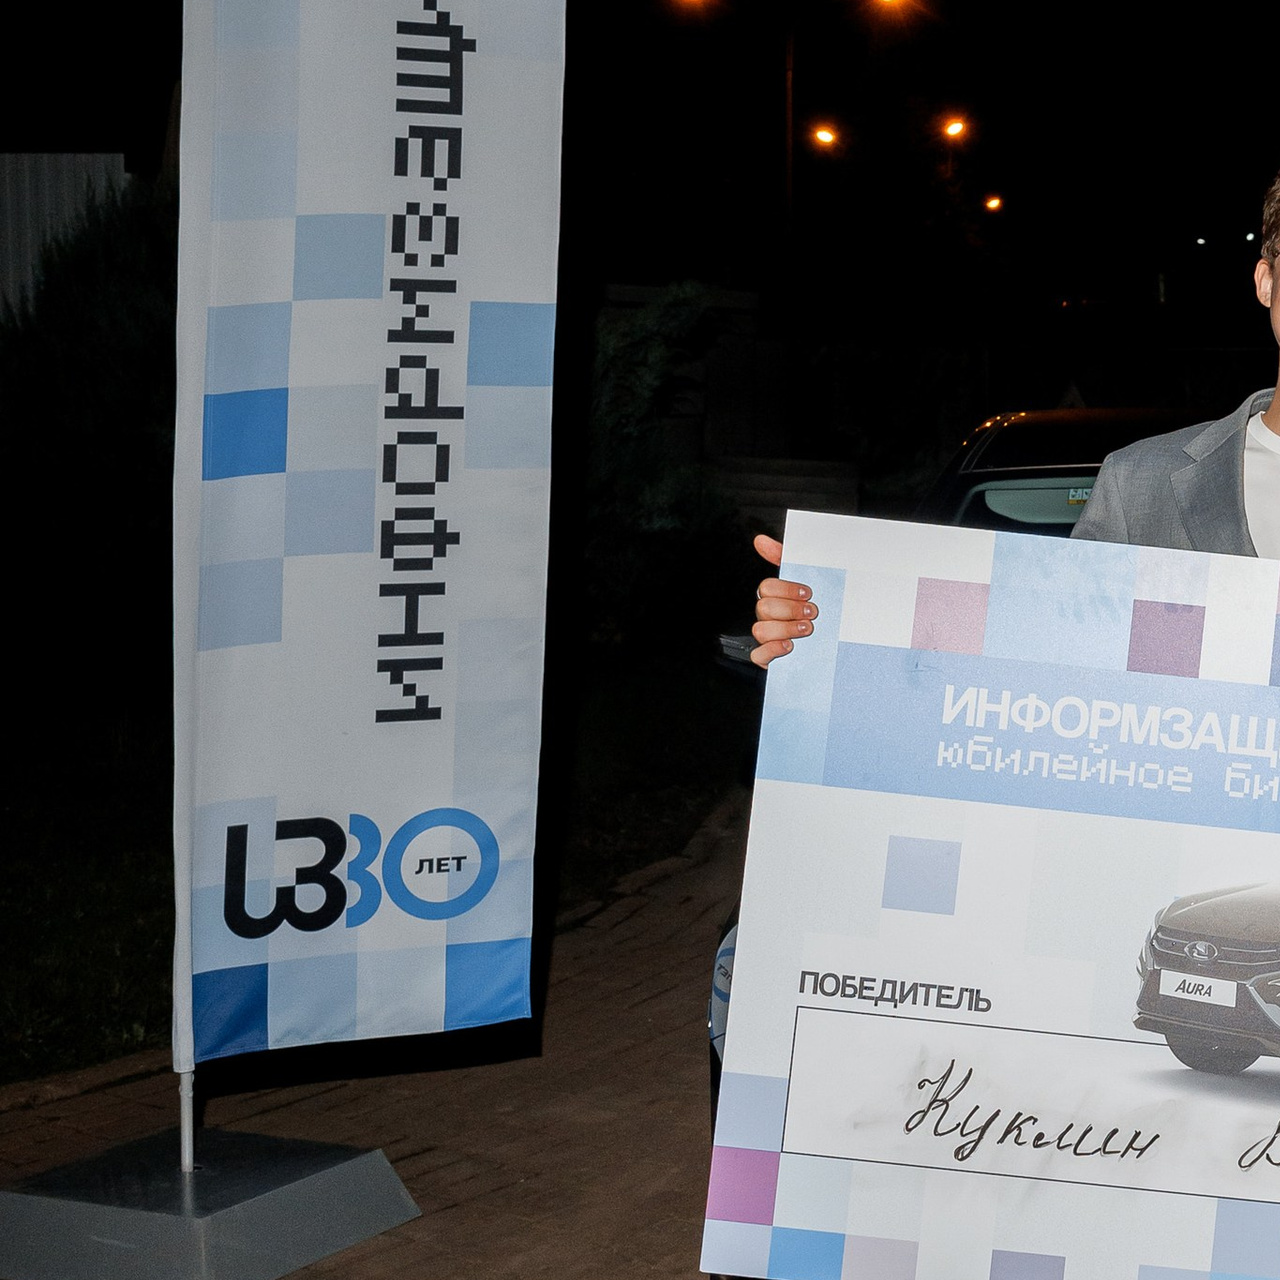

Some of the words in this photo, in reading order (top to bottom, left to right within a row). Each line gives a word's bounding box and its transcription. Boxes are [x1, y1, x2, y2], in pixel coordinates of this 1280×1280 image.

[936, 734, 1193, 793] юбилейное
[415, 855, 468, 875] ЛЕТ
[799, 970, 992, 1013] ПОБЕДИТЕЛЬ
[1174, 979, 1213, 997] AURA
